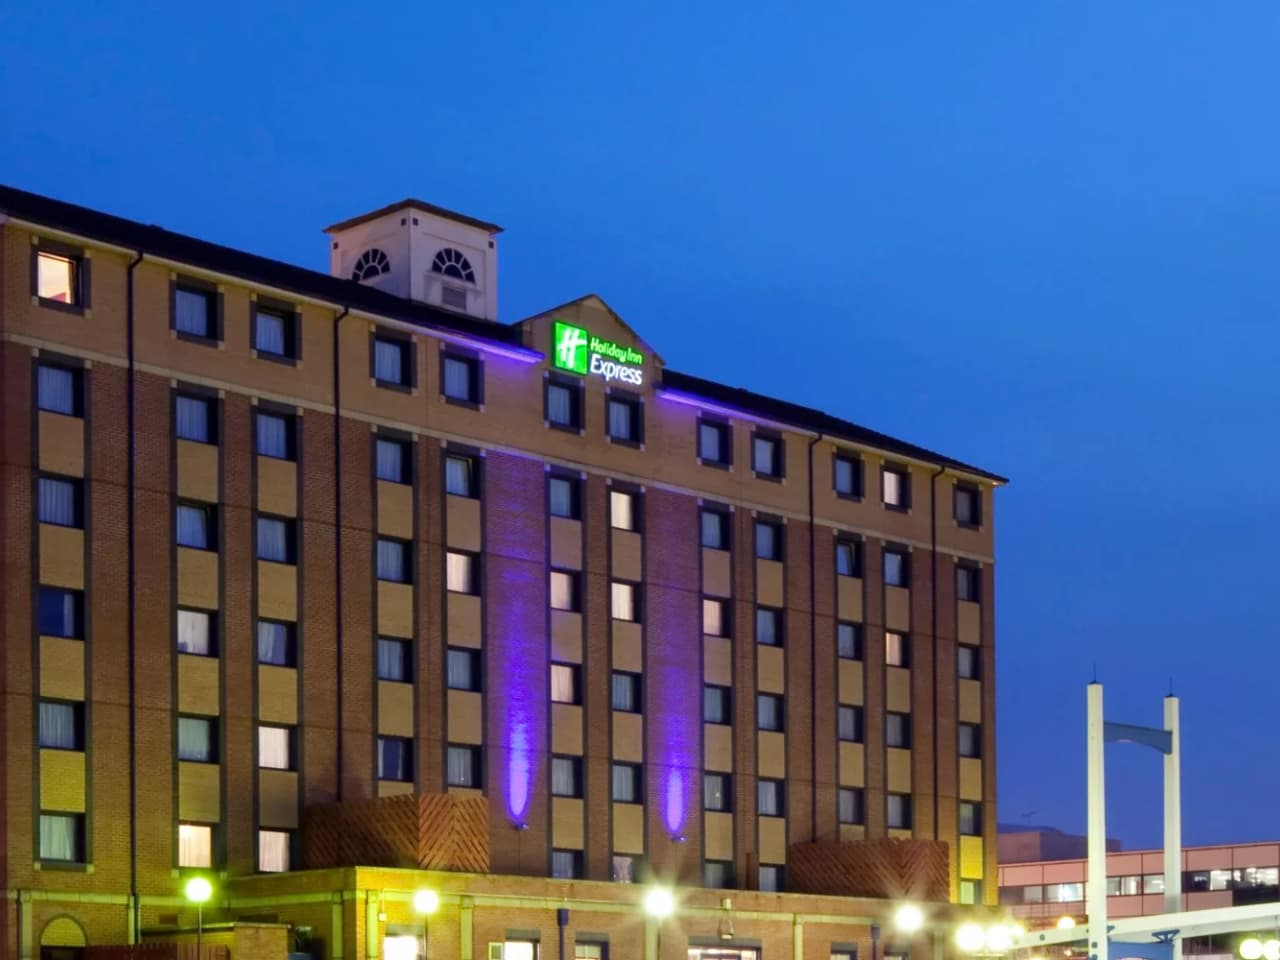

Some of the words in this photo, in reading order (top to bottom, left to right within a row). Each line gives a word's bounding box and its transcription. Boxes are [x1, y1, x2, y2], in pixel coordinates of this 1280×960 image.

[590, 336, 627, 363] Holiday
[627, 347, 643, 365] Inn
[590, 353, 643, 385] Express
